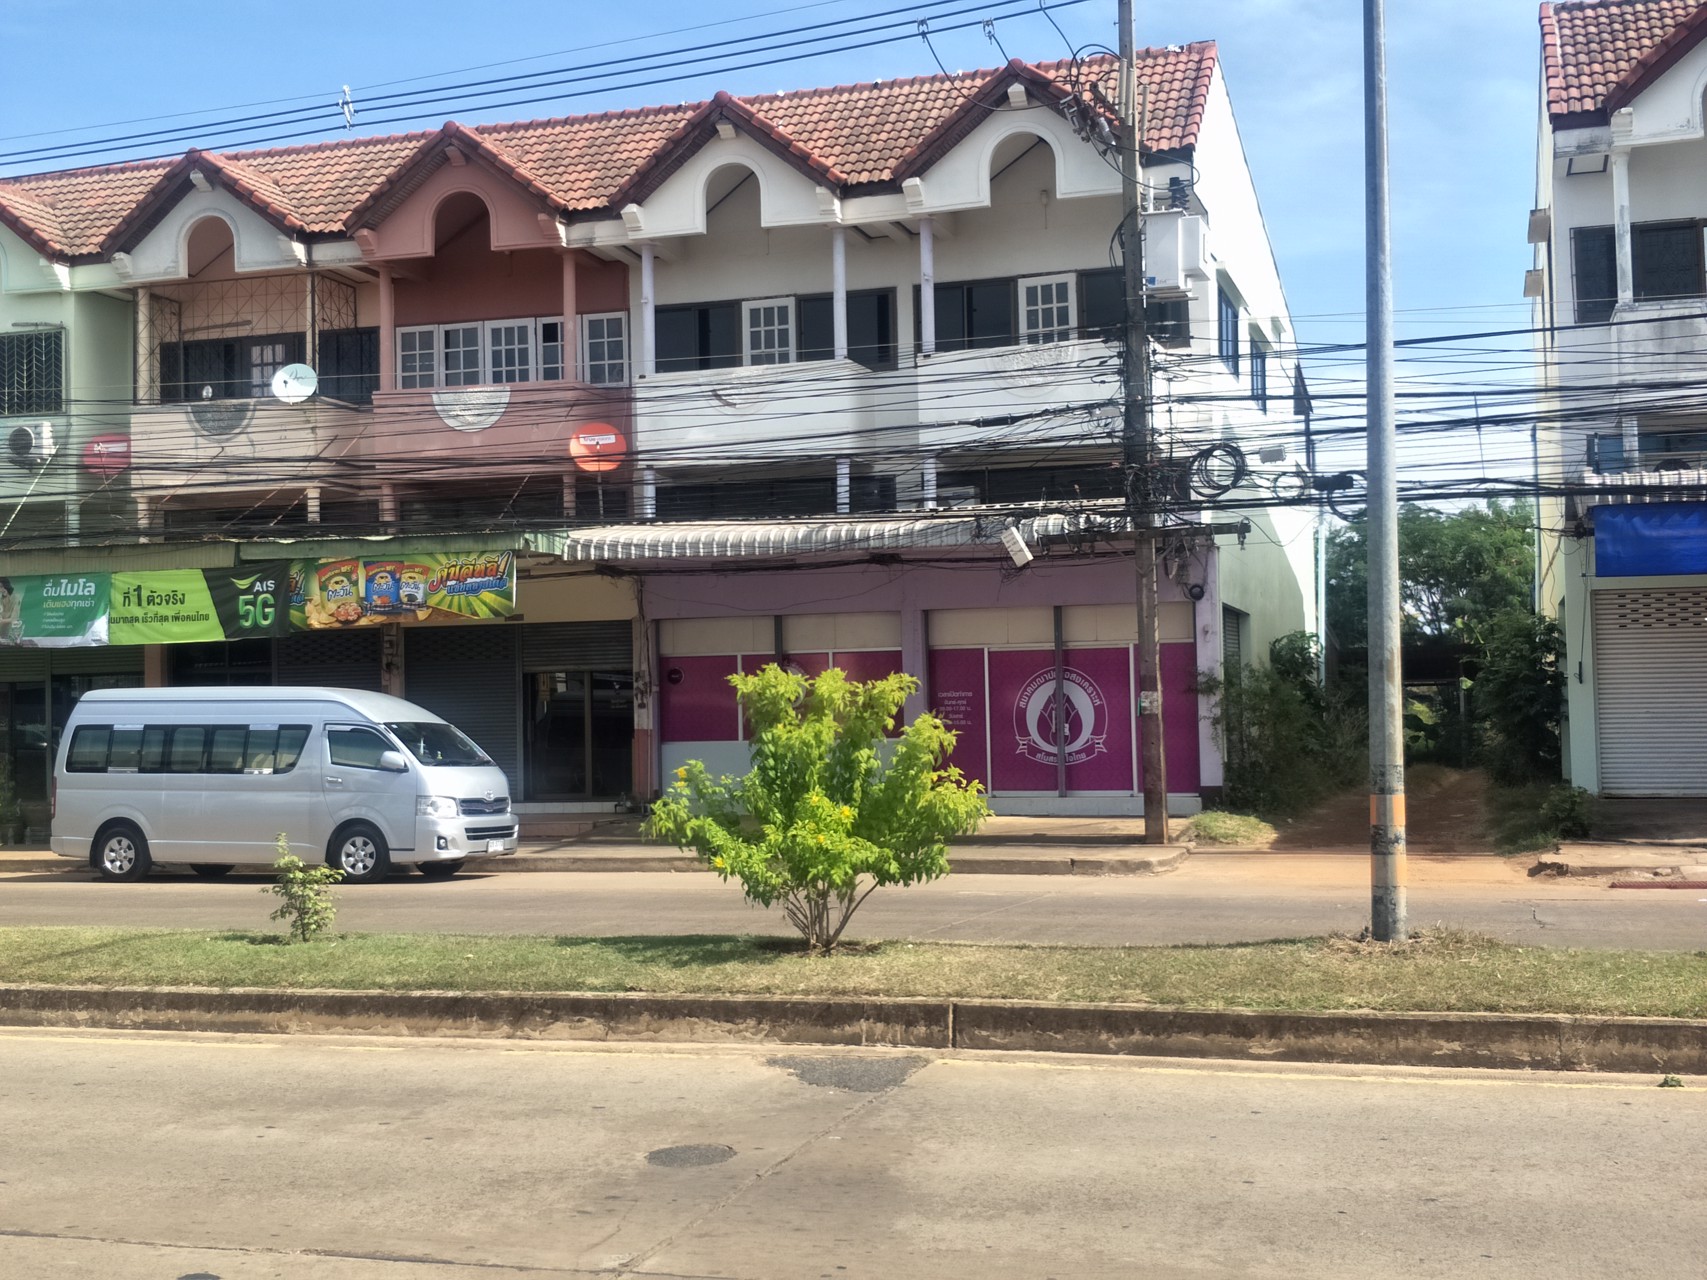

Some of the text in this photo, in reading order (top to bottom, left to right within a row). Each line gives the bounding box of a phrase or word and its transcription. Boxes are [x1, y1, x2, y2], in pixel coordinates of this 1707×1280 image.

[42, 578, 96, 598] ดื่มไมโล
[122, 584, 186, 608] ที่ 1 ตัวจริง
[253, 580, 276, 593] AIS
[326, 583, 354, 602] ตะวัน
[141, 611, 170, 627] เร็วที่สุด
[171, 610, 210, 623] เพื่อคนไทย
[238, 593, 276, 629] 5G
